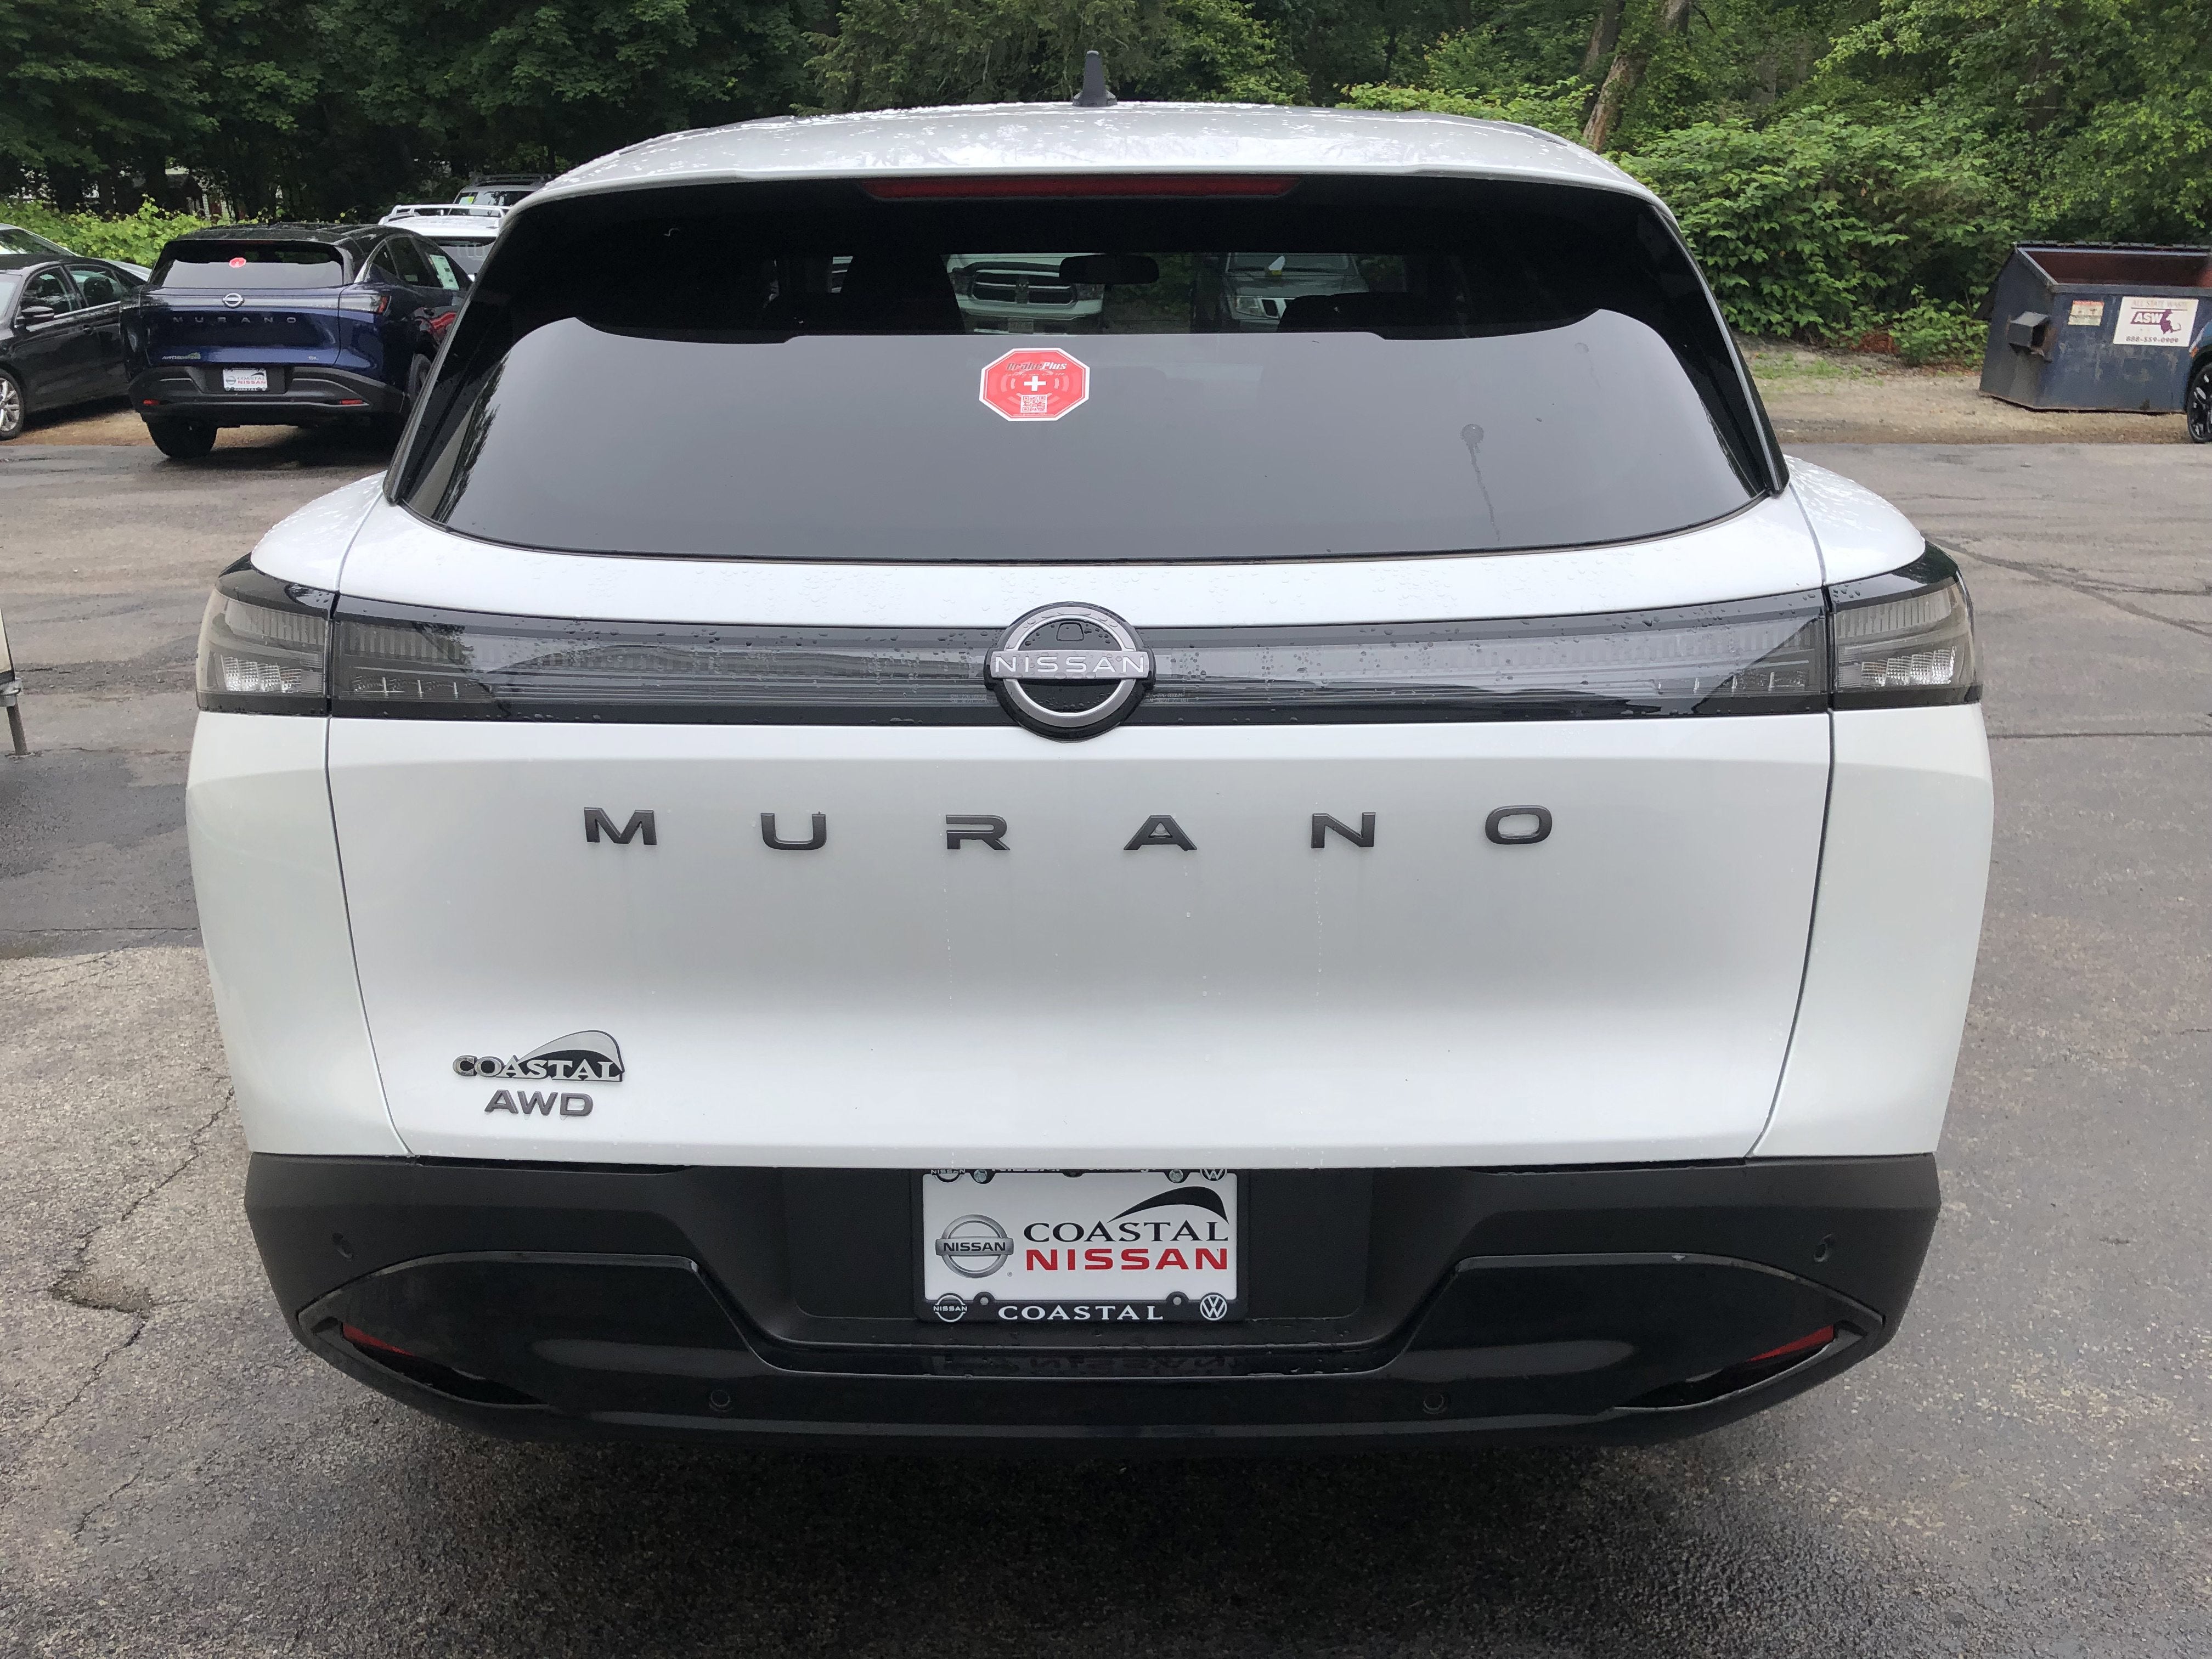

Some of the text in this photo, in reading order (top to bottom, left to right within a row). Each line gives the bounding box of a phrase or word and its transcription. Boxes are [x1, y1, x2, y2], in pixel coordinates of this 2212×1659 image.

[2134, 312, 2163, 324] ASW
[995, 656, 1144, 673] NISSAN
[584, 804, 1553, 850] MURANO
[452, 1054, 623, 1082] COASTAL
[484, 1089, 594, 1117] AWD
[1023, 1220, 1229, 1243] COASTAL
[943, 1242, 1006, 1252] NISSAN
[1026, 1248, 1228, 1271] NISSAN
[998, 1305, 1164, 1321] COASTAL
